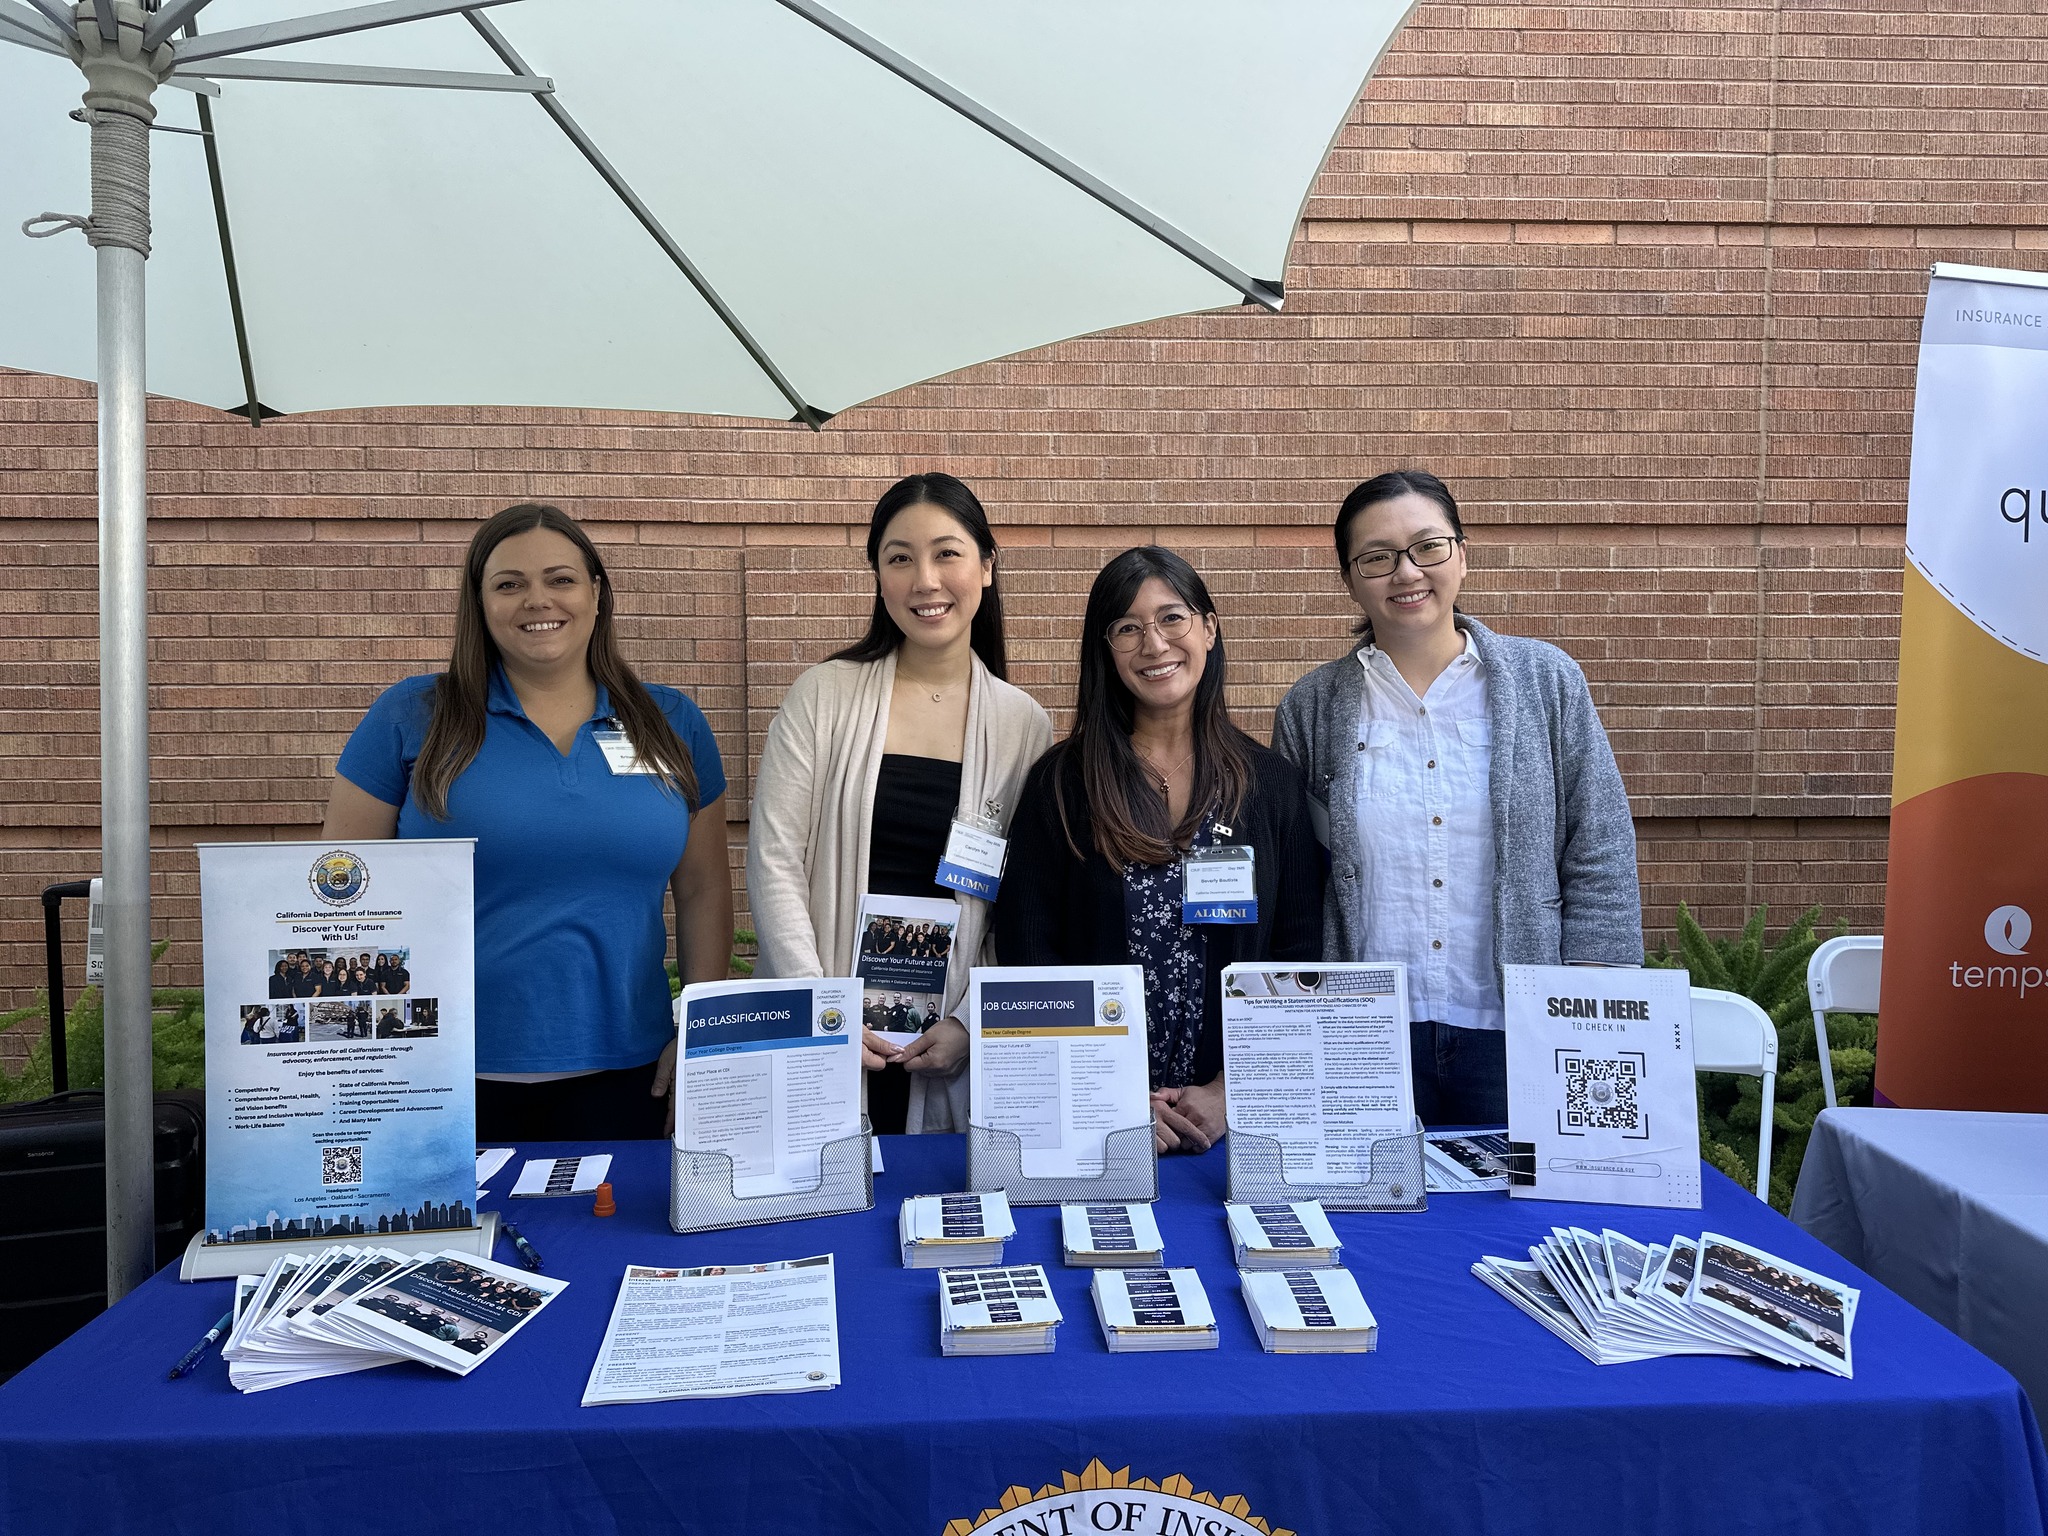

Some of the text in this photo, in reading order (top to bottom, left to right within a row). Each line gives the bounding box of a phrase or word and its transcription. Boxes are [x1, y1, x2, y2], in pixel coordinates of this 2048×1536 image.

[1956, 309, 2042, 328] INSURANCE
[2000, 487, 2048, 543] q
[945, 873, 990, 894] ALUMNI
[314, 910, 356, 919] Department
[1194, 908, 1247, 918] ALUMNI
[292, 925, 331, 933] Discover
[862, 955, 888, 963] Discover
[905, 958, 925, 966] Future
[1949, 961, 2048, 999] temp
[982, 1000, 1075, 1011] JOB CLASSIFICATIONS
[1547, 997, 1650, 1020] SCAN HERE
[688, 1010, 790, 1030] JOB CLASSIFICATIONS
[1572, 1022, 1626, 1032] TO CHECK IN
[298, 1049, 328, 1057] protection
[282, 1057, 312, 1065] advocacy,
[314, 1056, 352, 1064] enforcement,
[366, 1054, 397, 1062] regulation.
[234, 1095, 278, 1104] Comprehensive
[339, 1090, 376, 1098] Supplemental
[358, 1107, 394, 1115] Development
[316, 1201, 369, 1210] www.insurance.ca.gov
[1707, 1259, 1748, 1277] Discover
[1750, 1276, 1774, 1288] Your
[1775, 1286, 1806, 1303] Future
[1821, 1307, 1839, 1317] CDI
[410, 1273, 447, 1288] Discover
[448, 1286, 466, 1296] Your
[467, 1293, 495, 1308] Future
[507, 1309, 524, 1318] CDI
[1090, 1501, 1146, 1532] OF
[1158, 1507, 1246, 1536] INS
